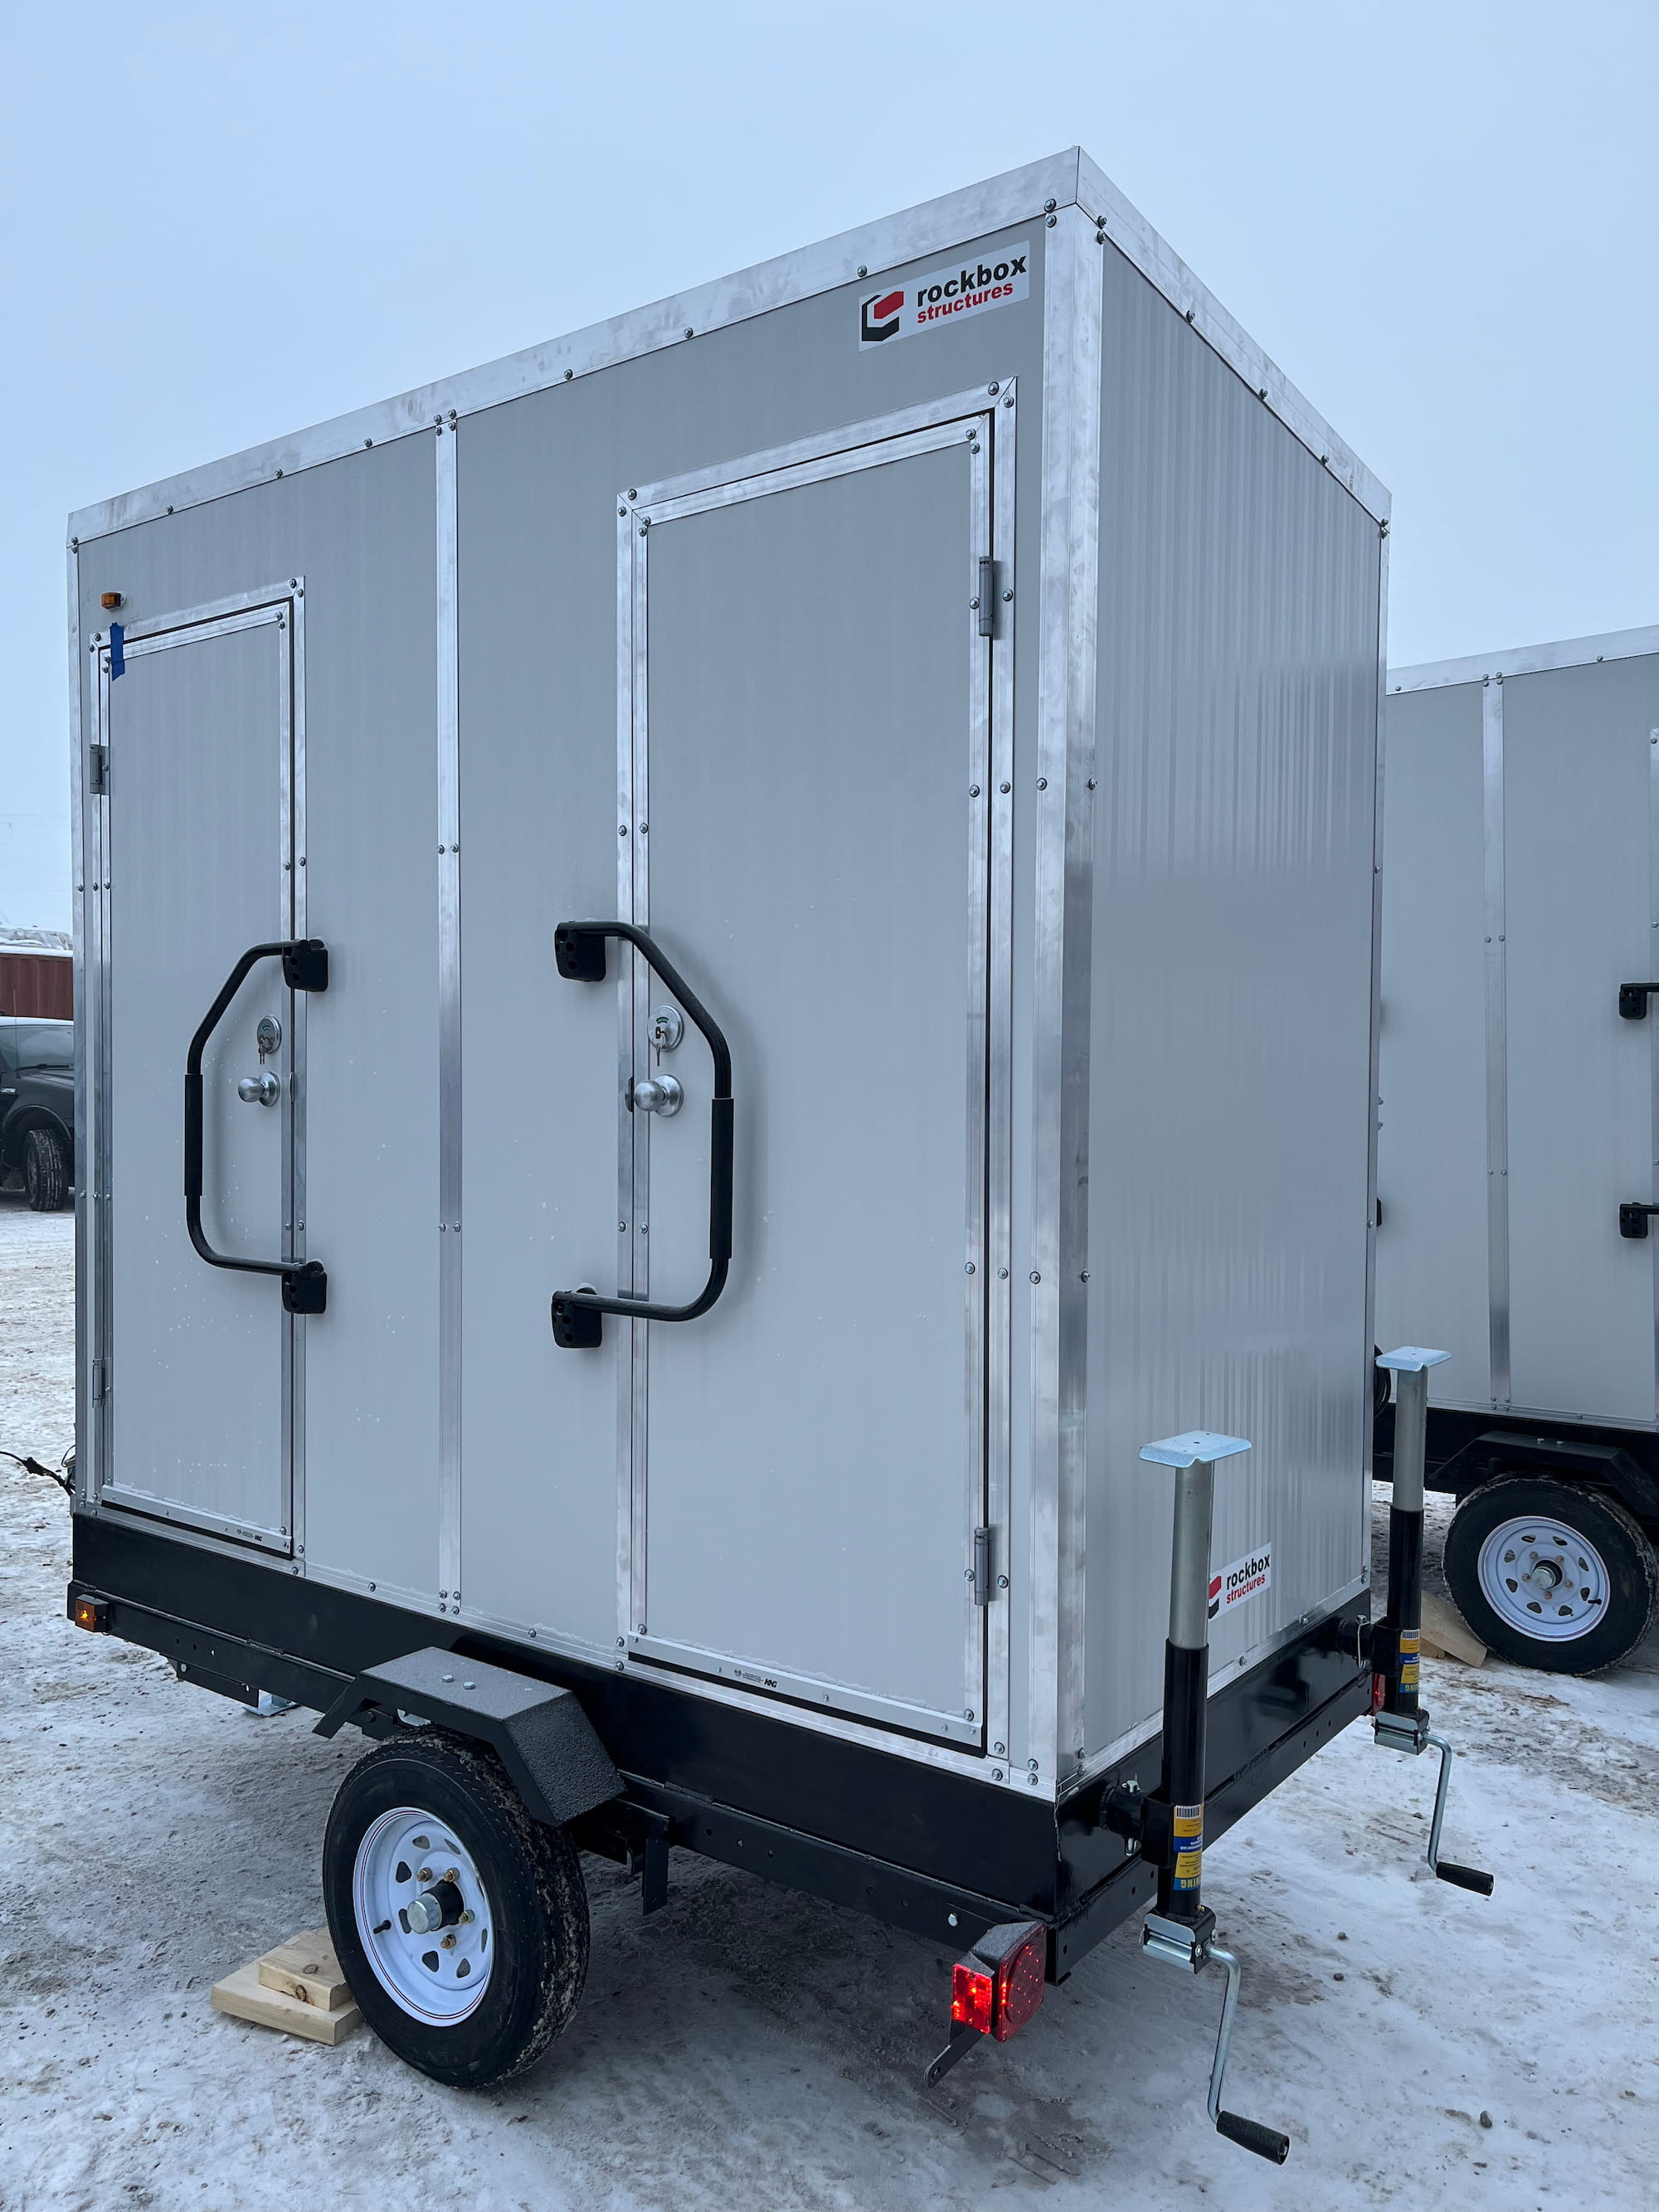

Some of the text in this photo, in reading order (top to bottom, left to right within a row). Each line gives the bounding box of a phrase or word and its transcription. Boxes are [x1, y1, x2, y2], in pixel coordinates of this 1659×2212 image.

[917, 255, 1027, 307] rockbox
[917, 283, 1014, 323] structures
[1226, 1553, 1270, 1591] rockbox
[1226, 1573, 1266, 1604] structures
